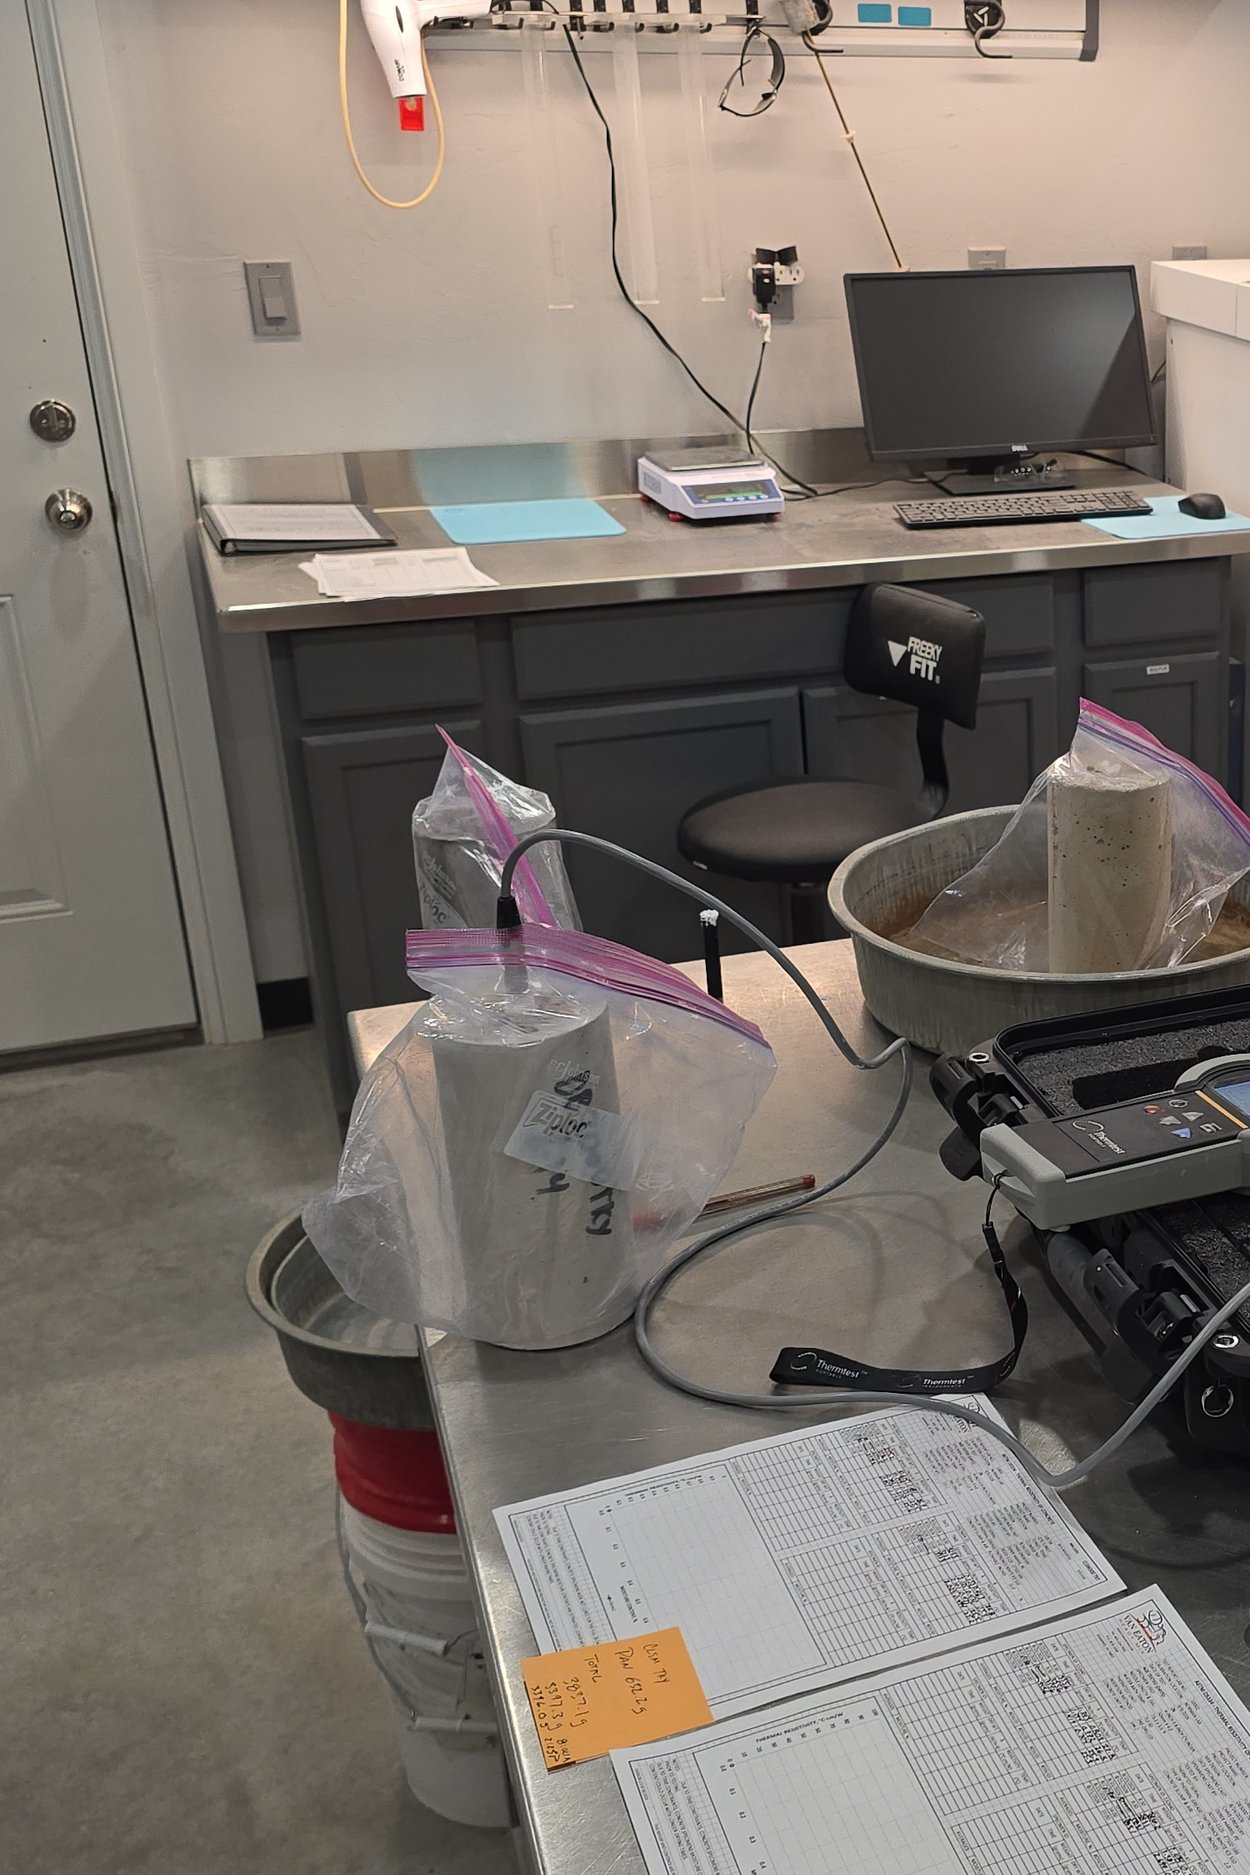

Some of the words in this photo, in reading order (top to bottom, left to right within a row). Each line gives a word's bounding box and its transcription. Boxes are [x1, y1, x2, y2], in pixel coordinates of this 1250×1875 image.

[908, 636, 942, 661] FREEKY
[530, 1102, 589, 1139] Ziploc
[817, 1359, 860, 1379] Thermtest
[923, 1378, 966, 1386] Thermtest
[1121, 1614, 1137, 1629] VAN
[1132, 1630, 1154, 1654] EATON
[584, 1654, 601, 1683] TOTAL
[615, 1647, 634, 1669] PAN
